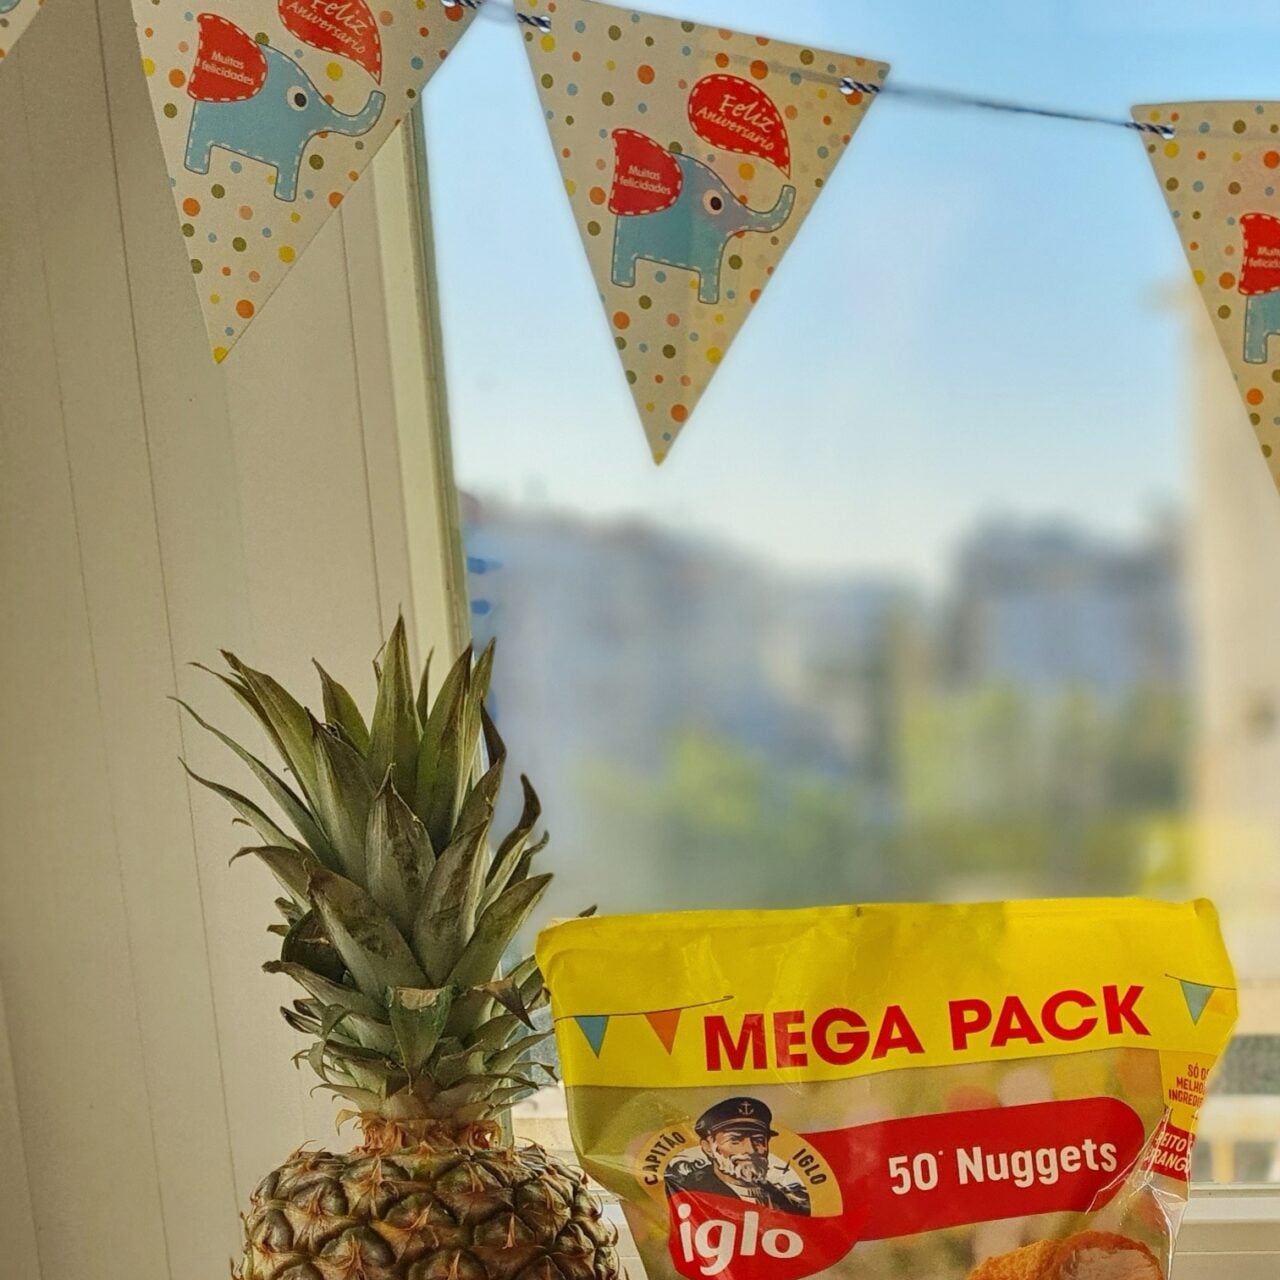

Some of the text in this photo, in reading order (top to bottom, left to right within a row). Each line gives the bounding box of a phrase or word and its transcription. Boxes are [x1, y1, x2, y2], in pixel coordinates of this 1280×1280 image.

[201, 60, 255, 86] felicidades
[211, 50, 245, 70] Muitas
[719, 94, 775, 133] Feliz
[619, 175, 672, 196] felicidades
[703, 984, 1152, 1071] MEGA PACK
[644, 1131, 687, 1186] CAPITÃO
[791, 1148, 827, 1186] IGLO
[956, 1138, 1118, 1189] Nuggets
[677, 1203, 804, 1276] iglo
